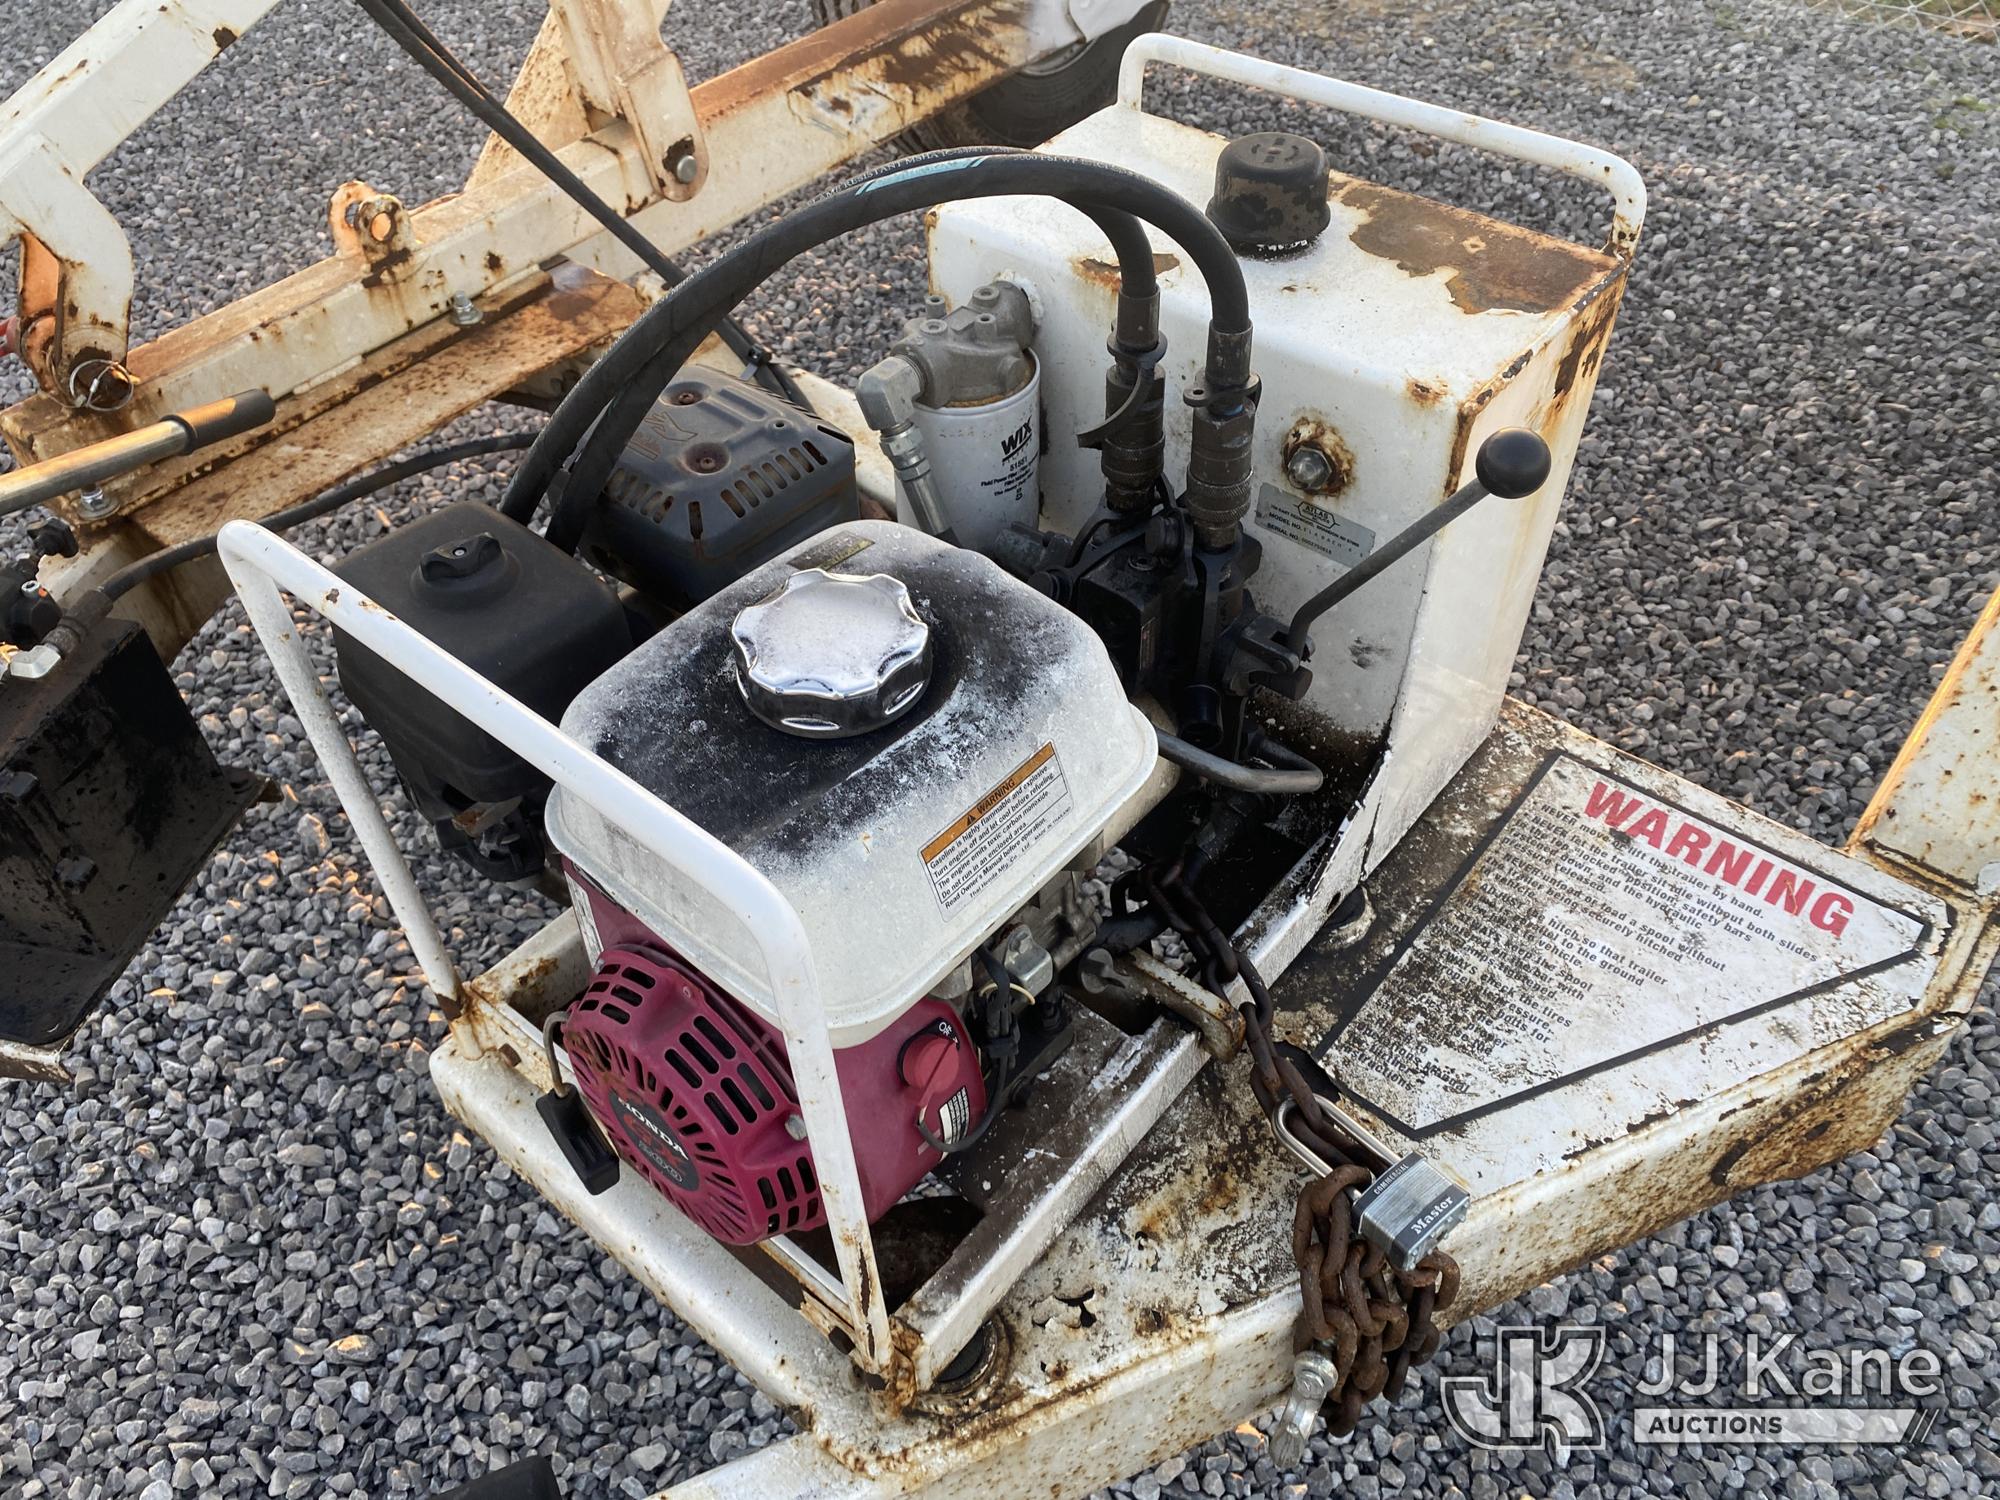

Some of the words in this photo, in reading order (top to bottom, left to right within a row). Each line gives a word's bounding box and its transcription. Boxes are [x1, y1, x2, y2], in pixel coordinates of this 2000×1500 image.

[844, 161, 902, 187] RESISTANT
[1001, 415, 1032, 455] WIX
[1267, 521, 1288, 536] SERIAL
[1269, 511, 1290, 525] MODEL
[1291, 522, 1302, 531] NO.
[1305, 504, 1328, 519] ATLAS
[977, 777, 1015, 815] WARNING
[929, 843, 955, 870] Gasoline
[955, 838, 962, 848] is
[961, 822, 980, 844] highly
[980, 795, 1011, 827] flammable
[1010, 786, 1022, 800] and
[934, 863, 948, 879] Turn
[947, 845, 968, 868] engine
[968, 837, 978, 849] off
[977, 827, 989, 841] and
[989, 819, 998, 830] let
[998, 808, 1011, 823] cool
[1010, 792, 1029, 812] before
[938, 875, 950, 889] The
[950, 858, 970, 880] engine
[970, 843, 987, 861] emits
[987, 830, 1002, 847] toxic
[1001, 812, 1022, 834] carbon
[941, 887, 951, 899] Do
[950, 878, 961, 891] not
[961, 868, 972, 882] run
[972, 862, 979, 871] in
[978, 855, 987, 866] an
[987, 832, 1013, 859] enclosed
[944, 892, 960, 909] Read
[960, 872, 982, 896] Owner's
[982, 854, 1003, 876] Manual
[1002, 838, 1020, 858] before
[1500, 836, 1553, 867] pressure
[1552, 861, 1610, 894] released.
[1508, 827, 1559, 857] fastened
[1596, 871, 1621, 888] and
[1621, 884, 1645, 900] the
[1644, 896, 1704, 930] hydraulic
[1540, 804, 1577, 825] NEVER
[1578, 823, 1610, 842] move
[1627, 846, 1648, 860] lift
[1669, 866, 1711, 891] trailer
[1711, 886, 1730, 901] by
[1729, 896, 1768, 919] hand.
[1582, 781, 1855, 939] WARNING
[1502, 852, 1541, 876] NEVER
[1583, 895, 1598, 906] or
[1628, 919, 1638, 927] a
[1638, 923, 1675, 946] spool
[1676, 942, 1728, 972] without
[1530, 815, 1569, 838] NEVER
[1588, 844, 1610, 858] the
[1608, 854, 1649, 878] trailer
[1649, 874, 1668, 887] sit
[1694, 896, 1745, 925] without
[1746, 921, 1778, 941] both
[1778, 937, 1821, 963] slides
[1548, 837, 1571, 852] top
[1680, 901, 1722, 927] safety
[1722, 923, 1754, 943] bars
[1478, 882, 1525, 910] ADJUST
[1547, 918, 1580, 939] hitch
[1580, 937, 1597, 949] so
[1599, 945, 1626, 963] that
[1626, 959, 1669, 986] trailer
[1543, 886, 1582, 911] being
[1579, 905, 1634, 938] securely
[1635, 933, 1685, 962] hitched
[1537, 938, 1586, 968] vehicle.
[1560, 938, 1576, 949] to
[1576, 946, 1599, 962] the
[1598, 958, 1645, 987] ground
[1555, 980, 1586, 1001] with
[1557, 968, 1594, 992] spool
[1518, 992, 1542, 1010] the
[1541, 1005, 1574, 1028] tires
[1414, 1040, 1430, 1054] to
[1529, 1027, 1552, 1044] for
[1373, 1164, 1410, 1195] COMMERCIAL
[1411, 1196, 1454, 1235] Master
